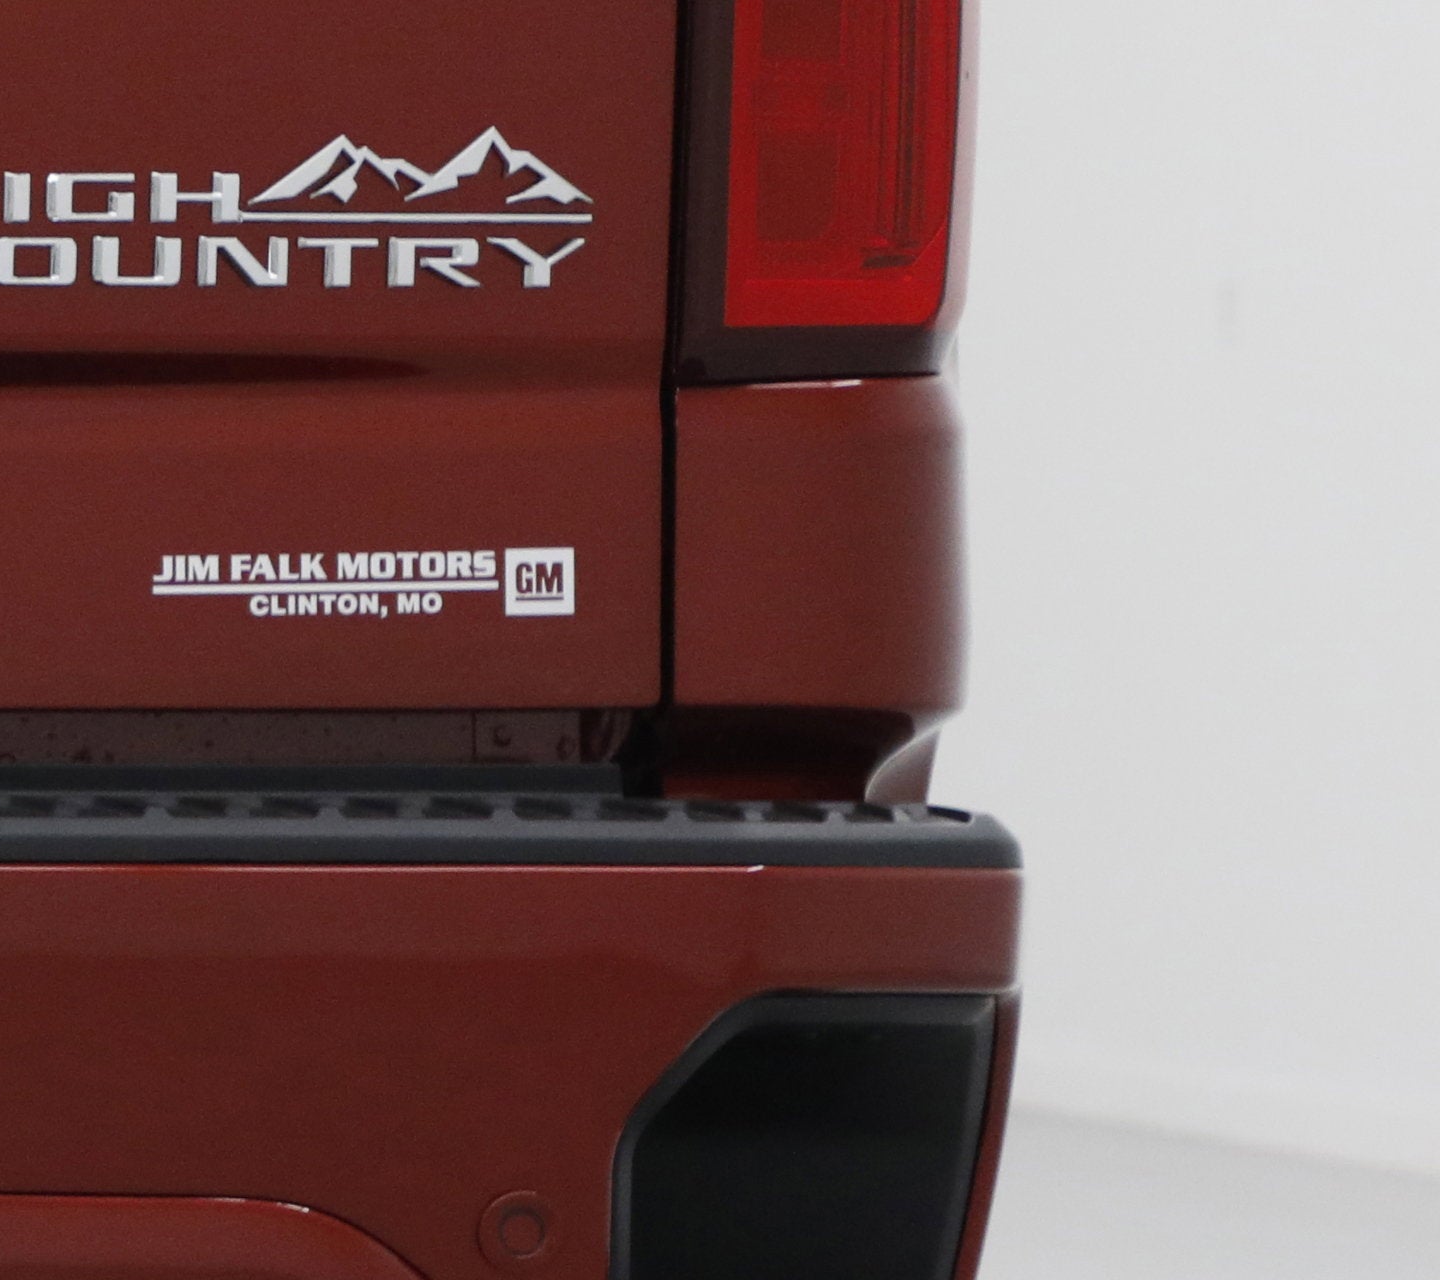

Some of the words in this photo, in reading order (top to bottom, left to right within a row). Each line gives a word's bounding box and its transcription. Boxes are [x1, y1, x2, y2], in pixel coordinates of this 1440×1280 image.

[153, 555, 219, 581] JIM
[231, 553, 327, 579] FALK
[338, 551, 496, 577] MOTORS
[515, 561, 564, 593] GM
[249, 593, 388, 619] CLINTON,
[396, 592, 442, 614] MO
